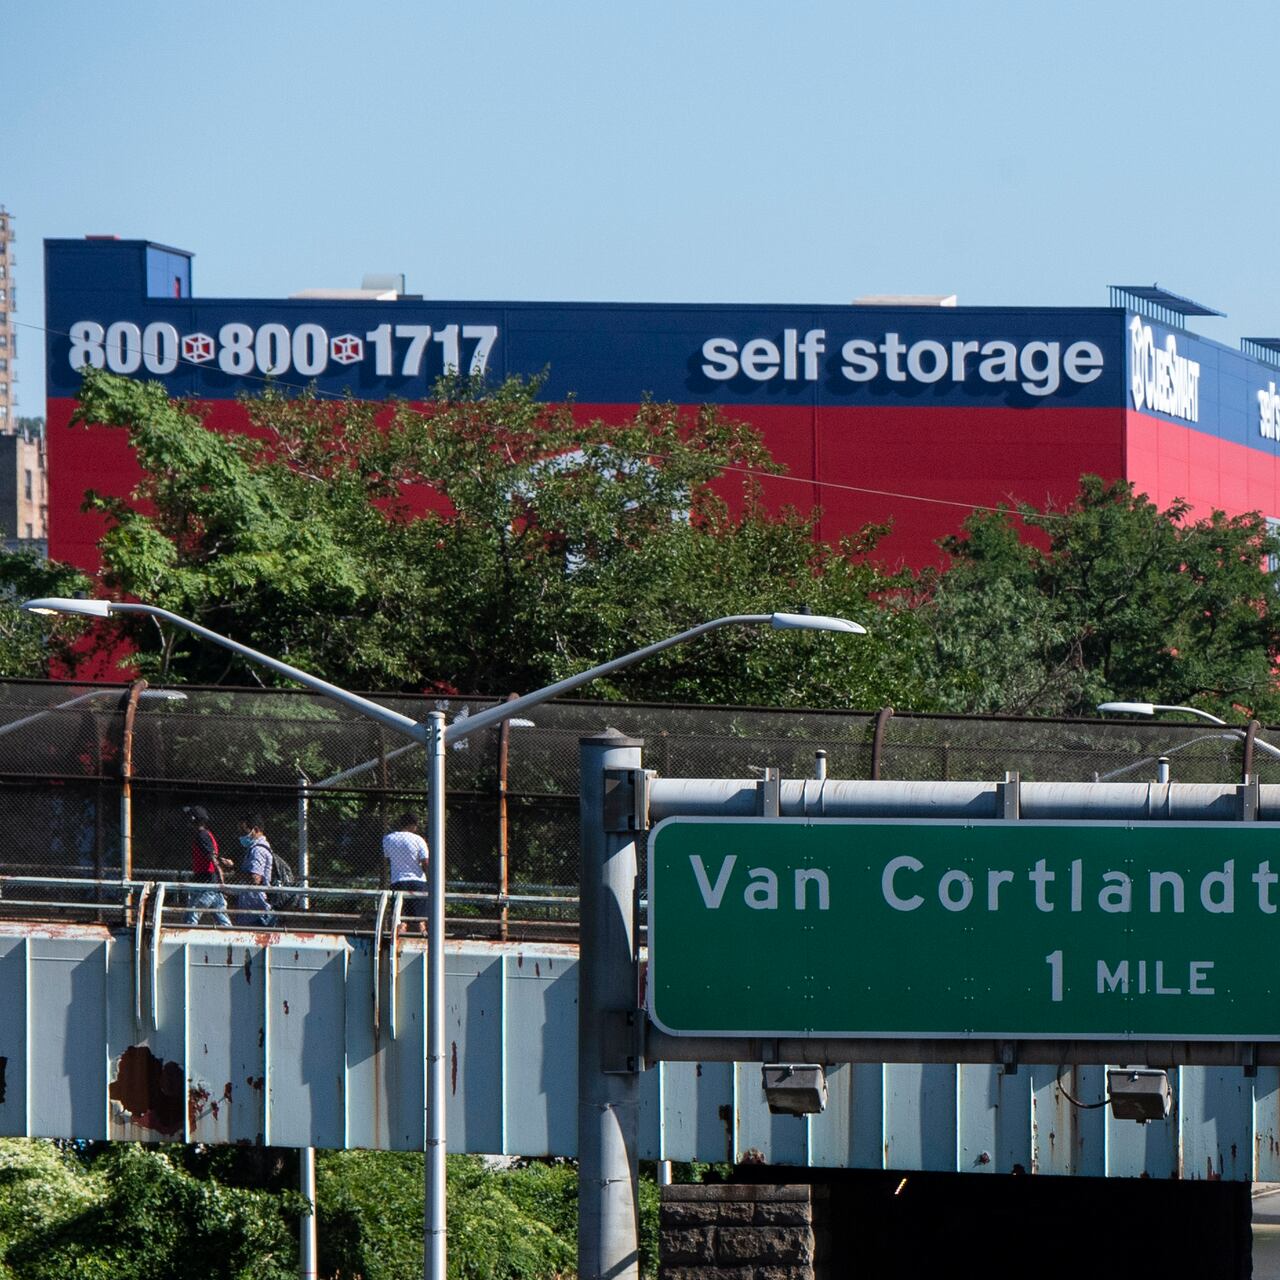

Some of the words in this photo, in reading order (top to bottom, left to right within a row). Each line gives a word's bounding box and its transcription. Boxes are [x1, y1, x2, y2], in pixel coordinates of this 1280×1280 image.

[366, 323, 498, 377] 1717
[702, 328, 826, 381] self
[841, 331, 1104, 397] storage
[689, 854, 830, 911] Van
[881, 855, 1279, 914] Cortlandt
[1045, 950, 1064, 1002] 1
[1097, 960, 1215, 995] MILE
